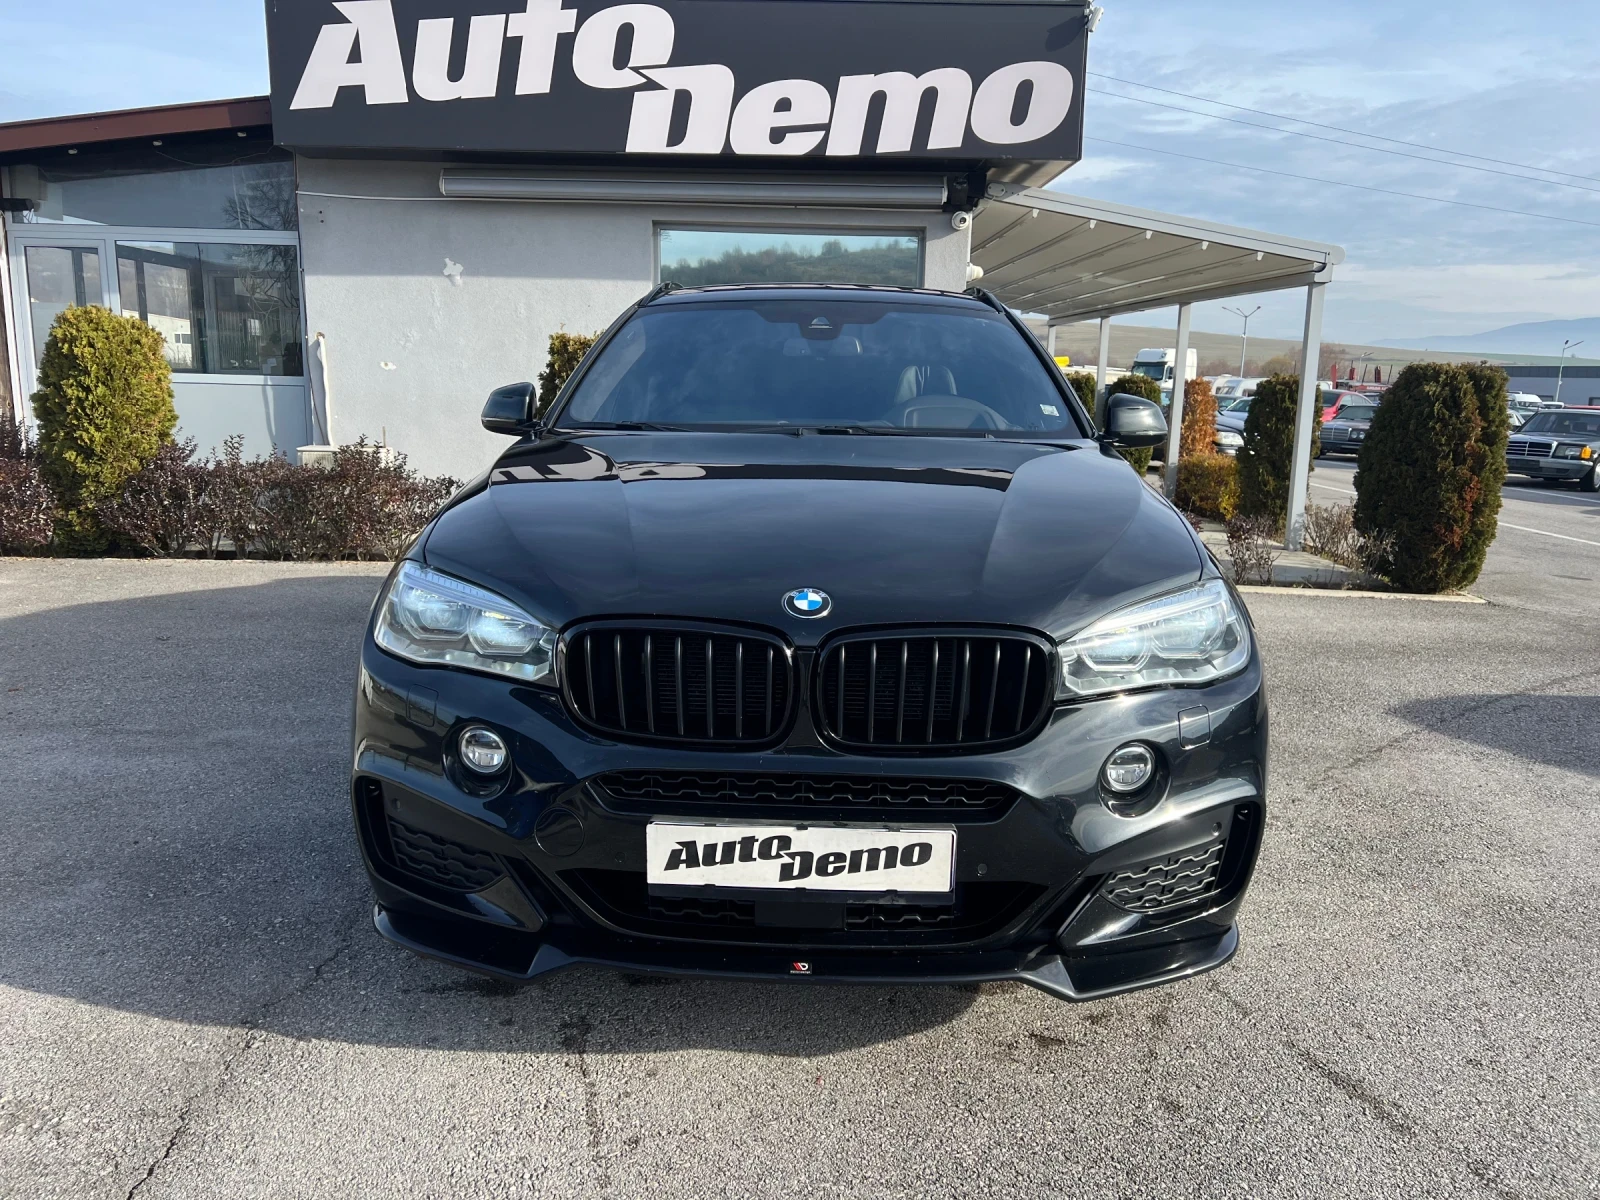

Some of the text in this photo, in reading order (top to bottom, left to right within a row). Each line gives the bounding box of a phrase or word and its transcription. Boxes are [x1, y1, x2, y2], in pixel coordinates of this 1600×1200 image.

[290, 0, 1073, 156] Auto Demo
[663, 835, 933, 883] Auto Demo
